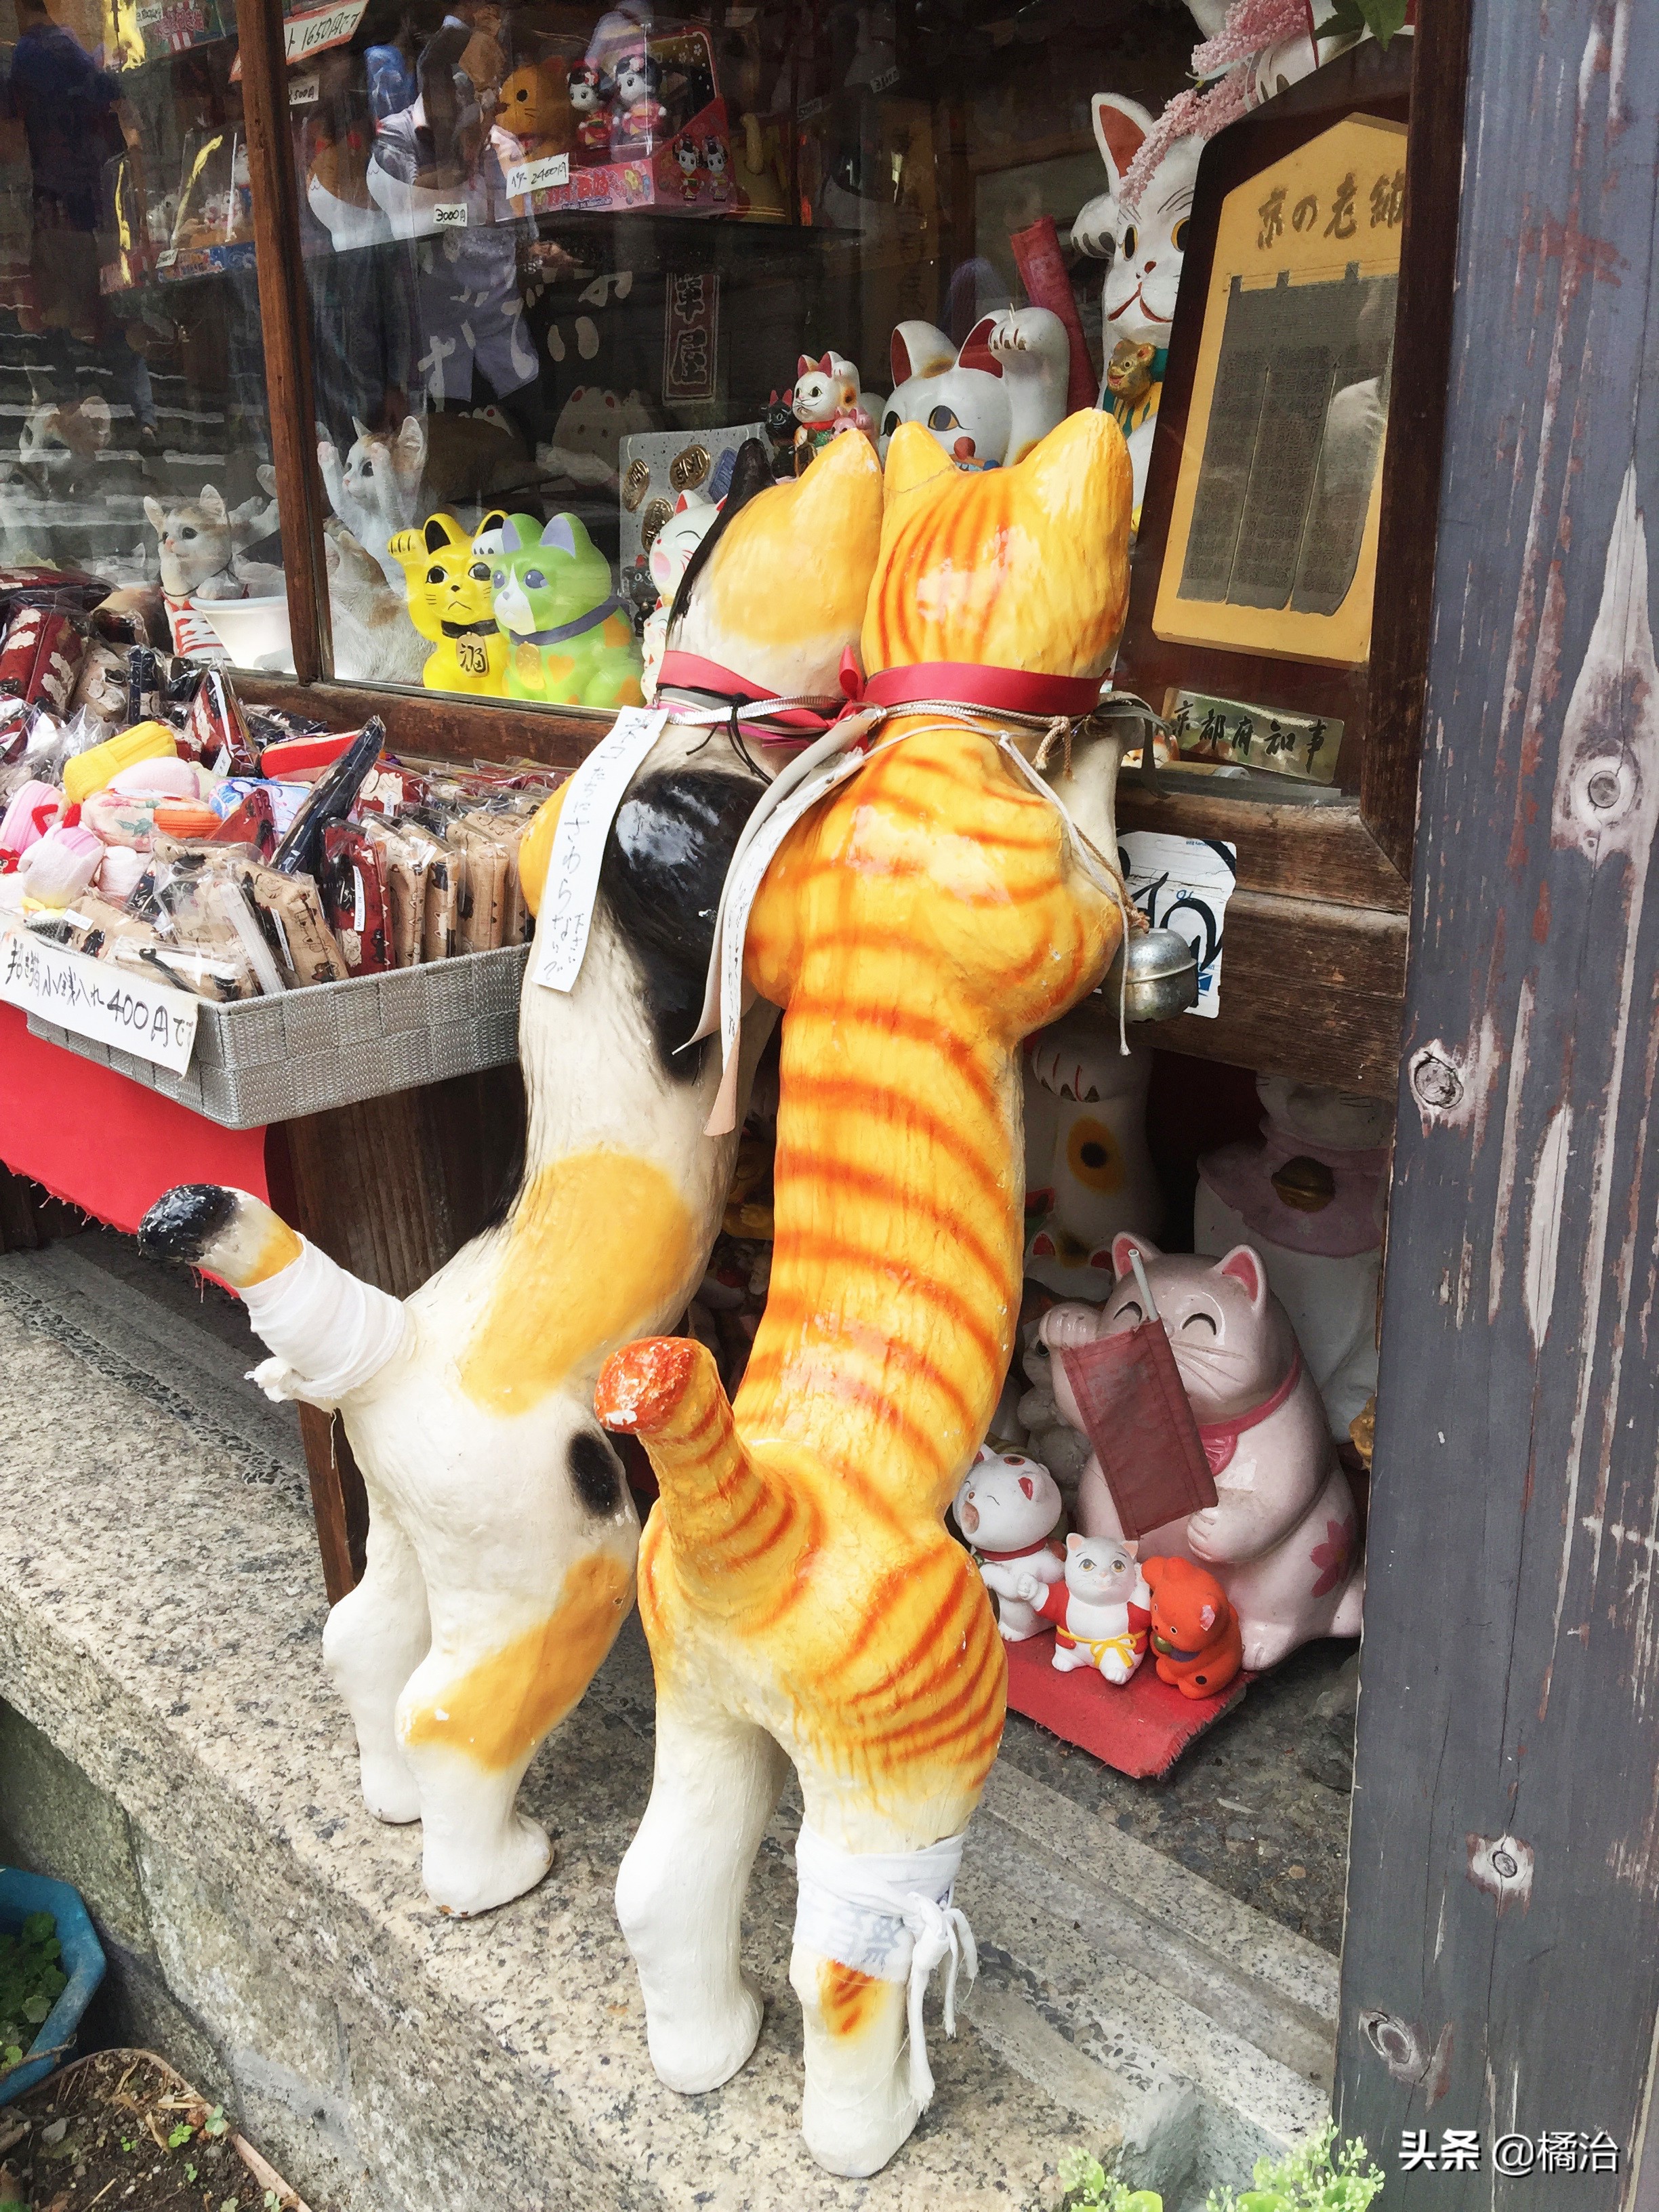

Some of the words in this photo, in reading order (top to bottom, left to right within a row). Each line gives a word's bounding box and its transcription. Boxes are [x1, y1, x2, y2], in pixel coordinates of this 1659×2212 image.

[1172, 699, 1328, 774] 京都府知事
